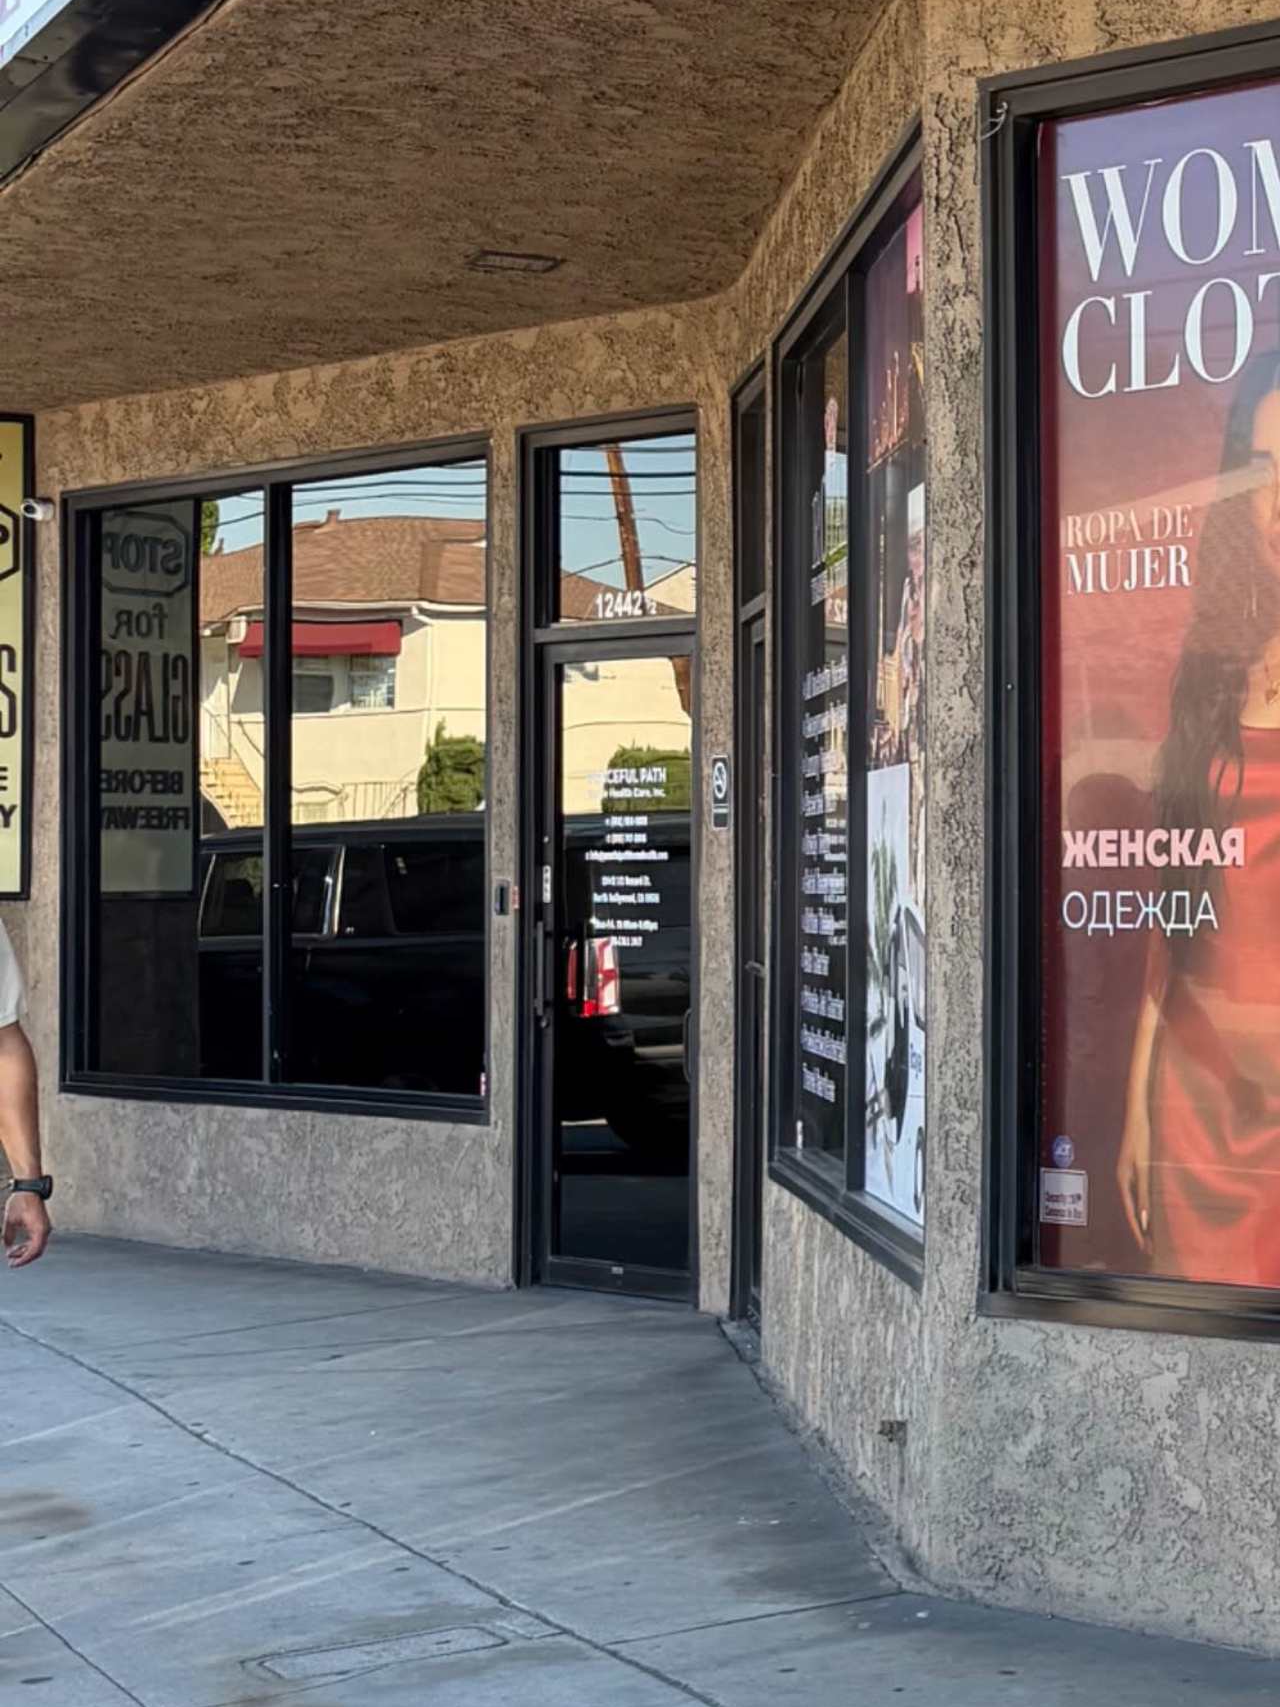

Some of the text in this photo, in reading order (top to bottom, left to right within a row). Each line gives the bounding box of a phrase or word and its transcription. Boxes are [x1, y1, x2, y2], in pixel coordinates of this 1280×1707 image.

[1066, 503, 1194, 548] ROPA DE
[1065, 543, 1194, 595] MUJER
[639, 765, 667, 784] PATH
[1061, 827, 1246, 868] ЖЕНСКАЯ
[1062, 890, 1219, 937] ОДЕЖДА
